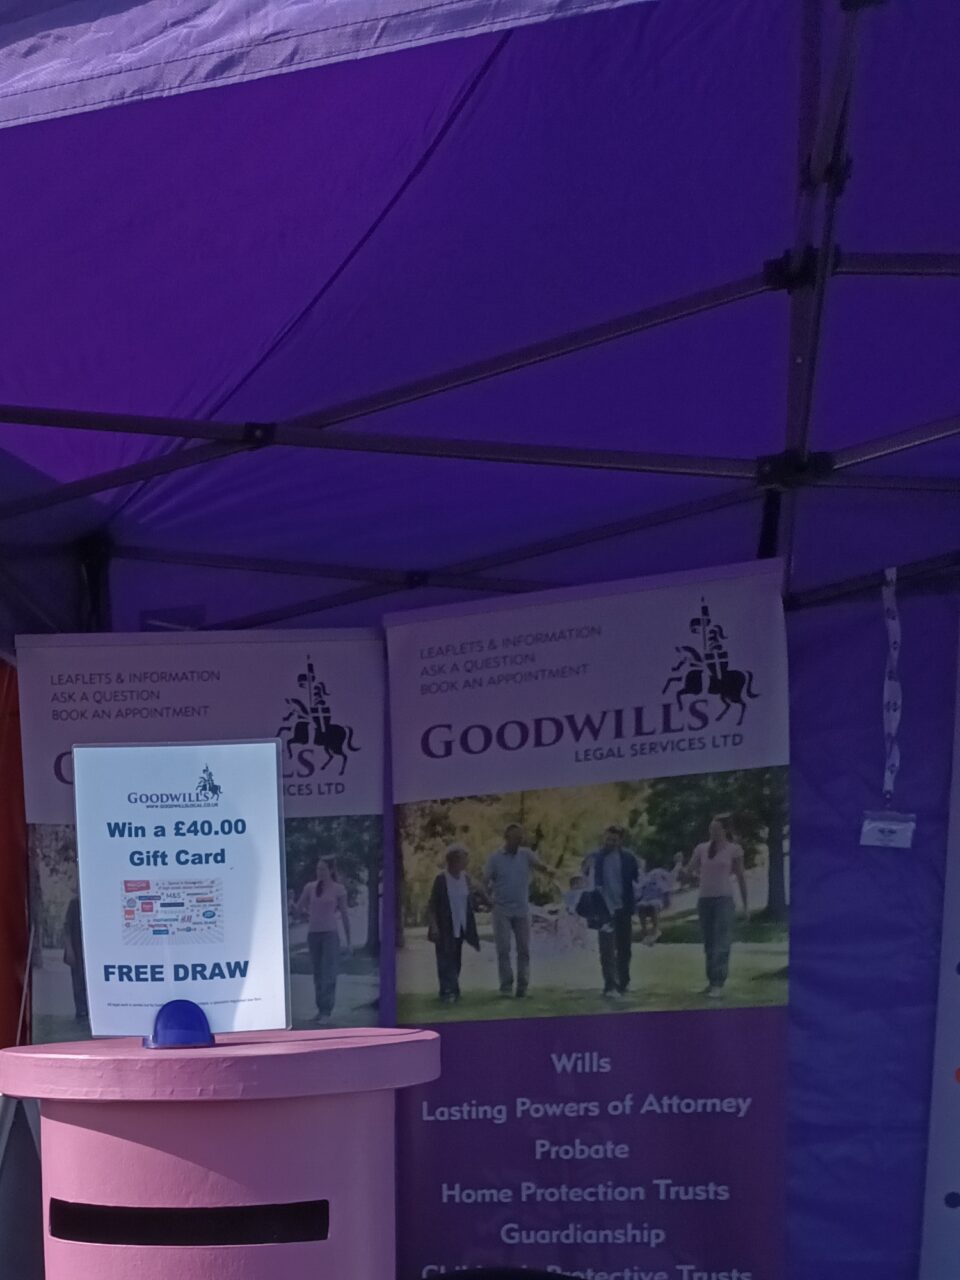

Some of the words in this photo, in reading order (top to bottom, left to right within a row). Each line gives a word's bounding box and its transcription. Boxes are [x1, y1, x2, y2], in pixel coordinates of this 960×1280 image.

[420, 639, 485, 660] LEAFLETS
[488, 638, 498, 651] &
[502, 625, 603, 649] INFORMATION
[50, 672, 112, 686] LEAFLETS
[116, 672, 125, 685] &
[128, 670, 221, 684] INFORMATION
[52, 708, 88, 721] BOOK
[92, 707, 111, 720] AN
[114, 705, 209, 719] APPOINTMENT
[420, 700, 710, 759] GOODWILLS
[574, 746, 625, 763] LEGAL
[630, 736, 706, 757] SERVICES
[711, 732, 744, 749] LTD
[127, 791, 210, 805] GOODWILLS
[318, 781, 345, 797] LTD
[107, 821, 146, 838] Win
[153, 825, 166, 838] a
[173, 818, 247, 837] £40.00
[128, 849, 168, 867] Gift
[175, 848, 226, 866] Card
[103, 964, 165, 982] FREE
[173, 960, 249, 981] DRAW
[550, 1052, 611, 1074] Wills
[422, 1100, 507, 1124] Lasting
[515, 1098, 600, 1118] Powers
[607, 1093, 633, 1115] of
[640, 1094, 752, 1118] Attorney
[535, 1139, 629, 1160] Probate
[441, 1182, 513, 1204] Home
[521, 1180, 645, 1203] Protection
[653, 1179, 730, 1202] Trusts
[500, 1223, 666, 1248] Guardianship
